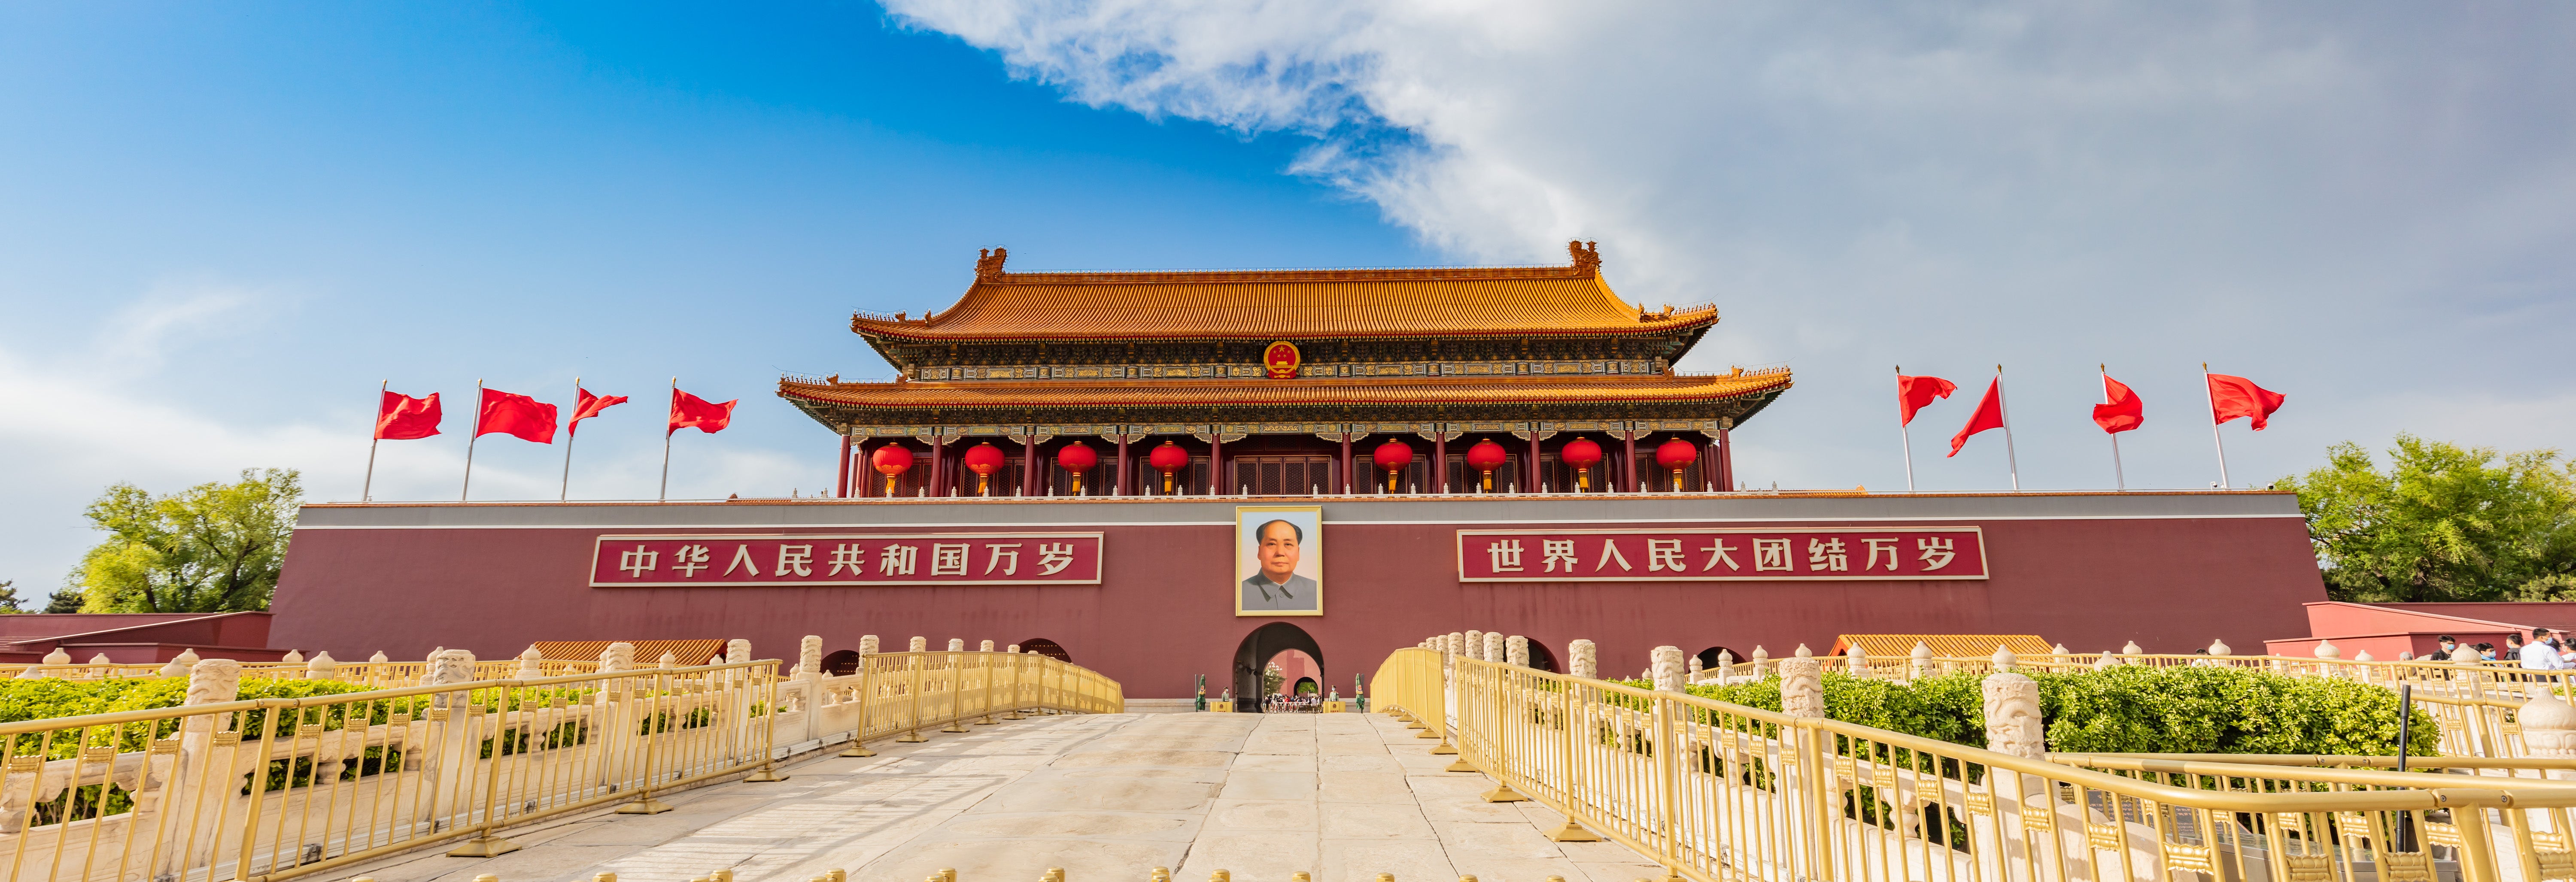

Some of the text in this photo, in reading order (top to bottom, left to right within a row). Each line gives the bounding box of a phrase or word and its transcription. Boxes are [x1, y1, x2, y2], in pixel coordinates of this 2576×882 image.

[620, 542, 1074, 578] 中华人民共和国万岁
[1486, 537, 1956, 573] 世界人民大团结万岁
